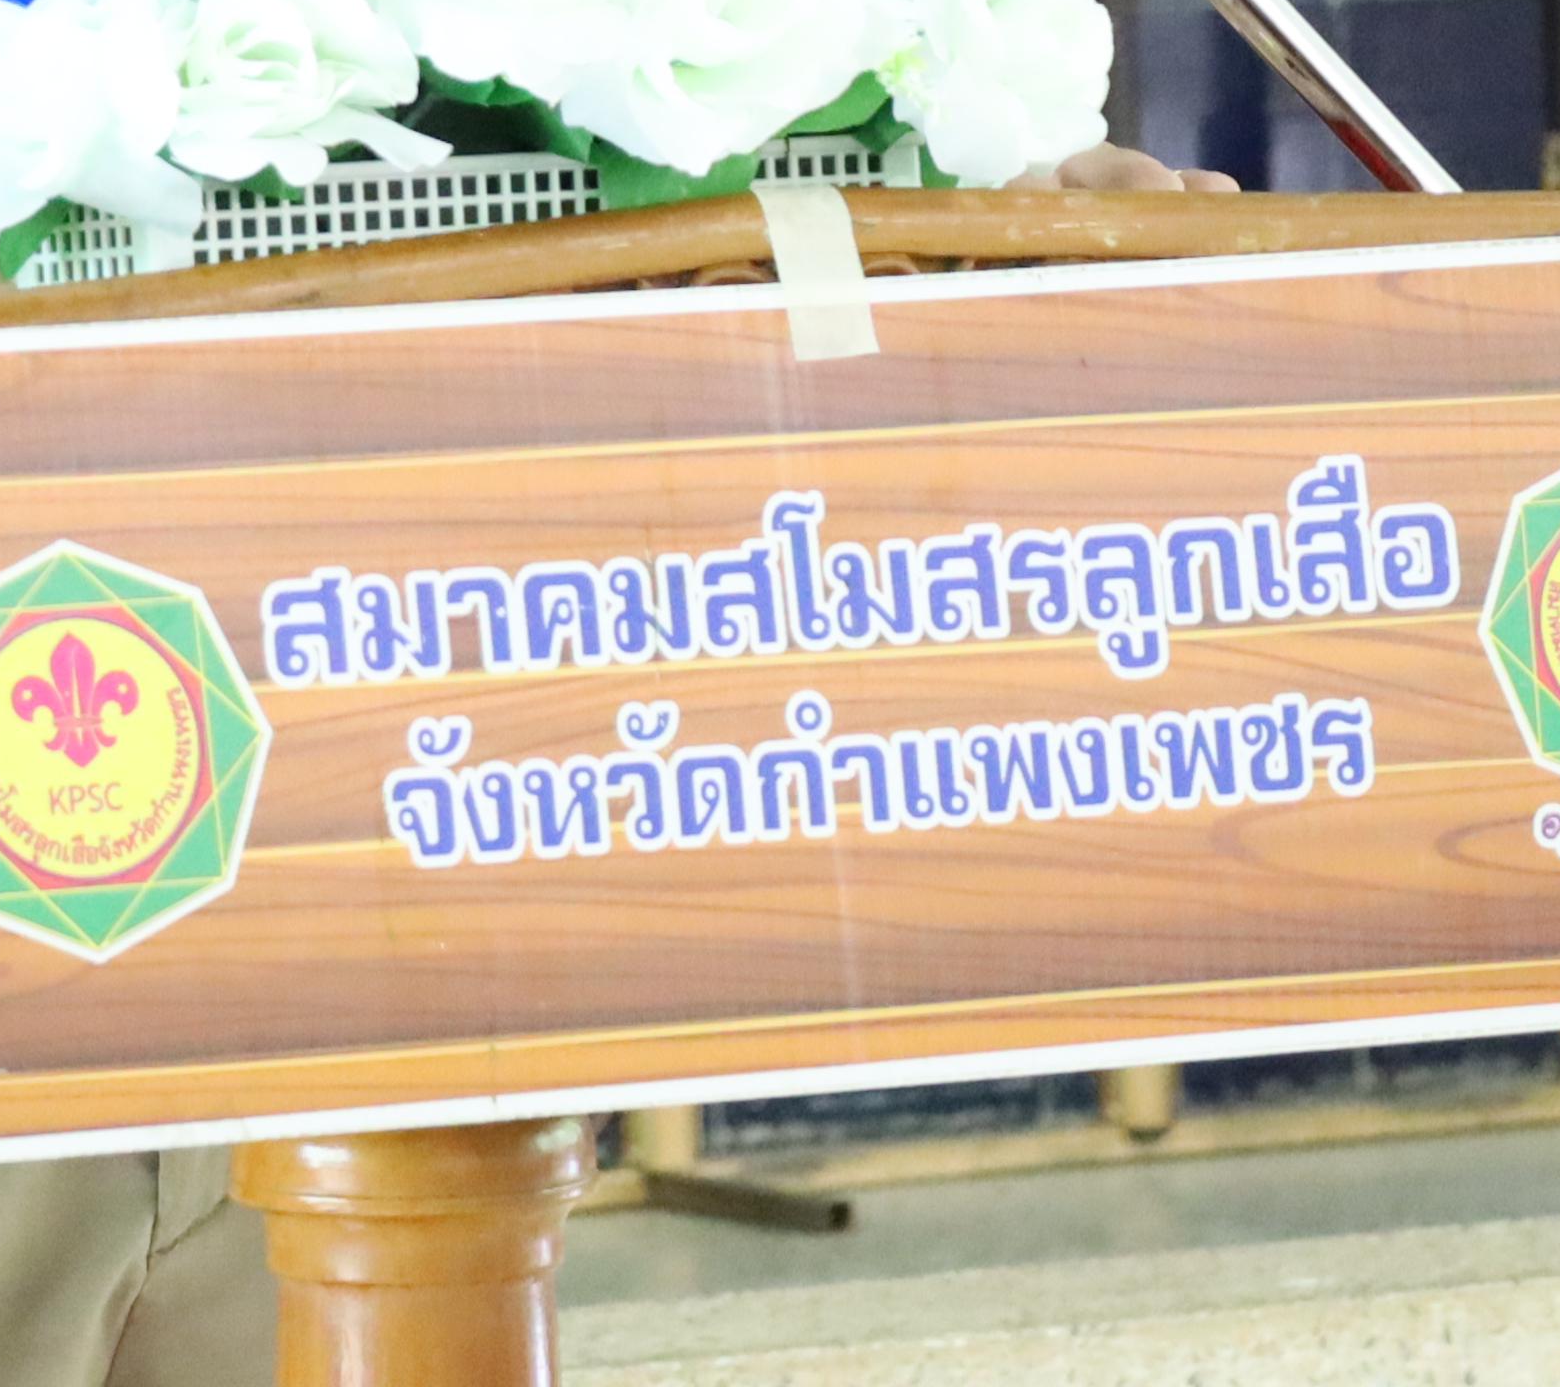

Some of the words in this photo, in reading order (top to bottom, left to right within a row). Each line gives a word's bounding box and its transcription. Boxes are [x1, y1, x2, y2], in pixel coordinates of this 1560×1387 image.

[269, 463, 1452, 678] สมาคมสโมสรลูกเสือ
[47, 781, 124, 816] KPSC
[391, 699, 1367, 857] จังหวัดกำแพงเพชร
